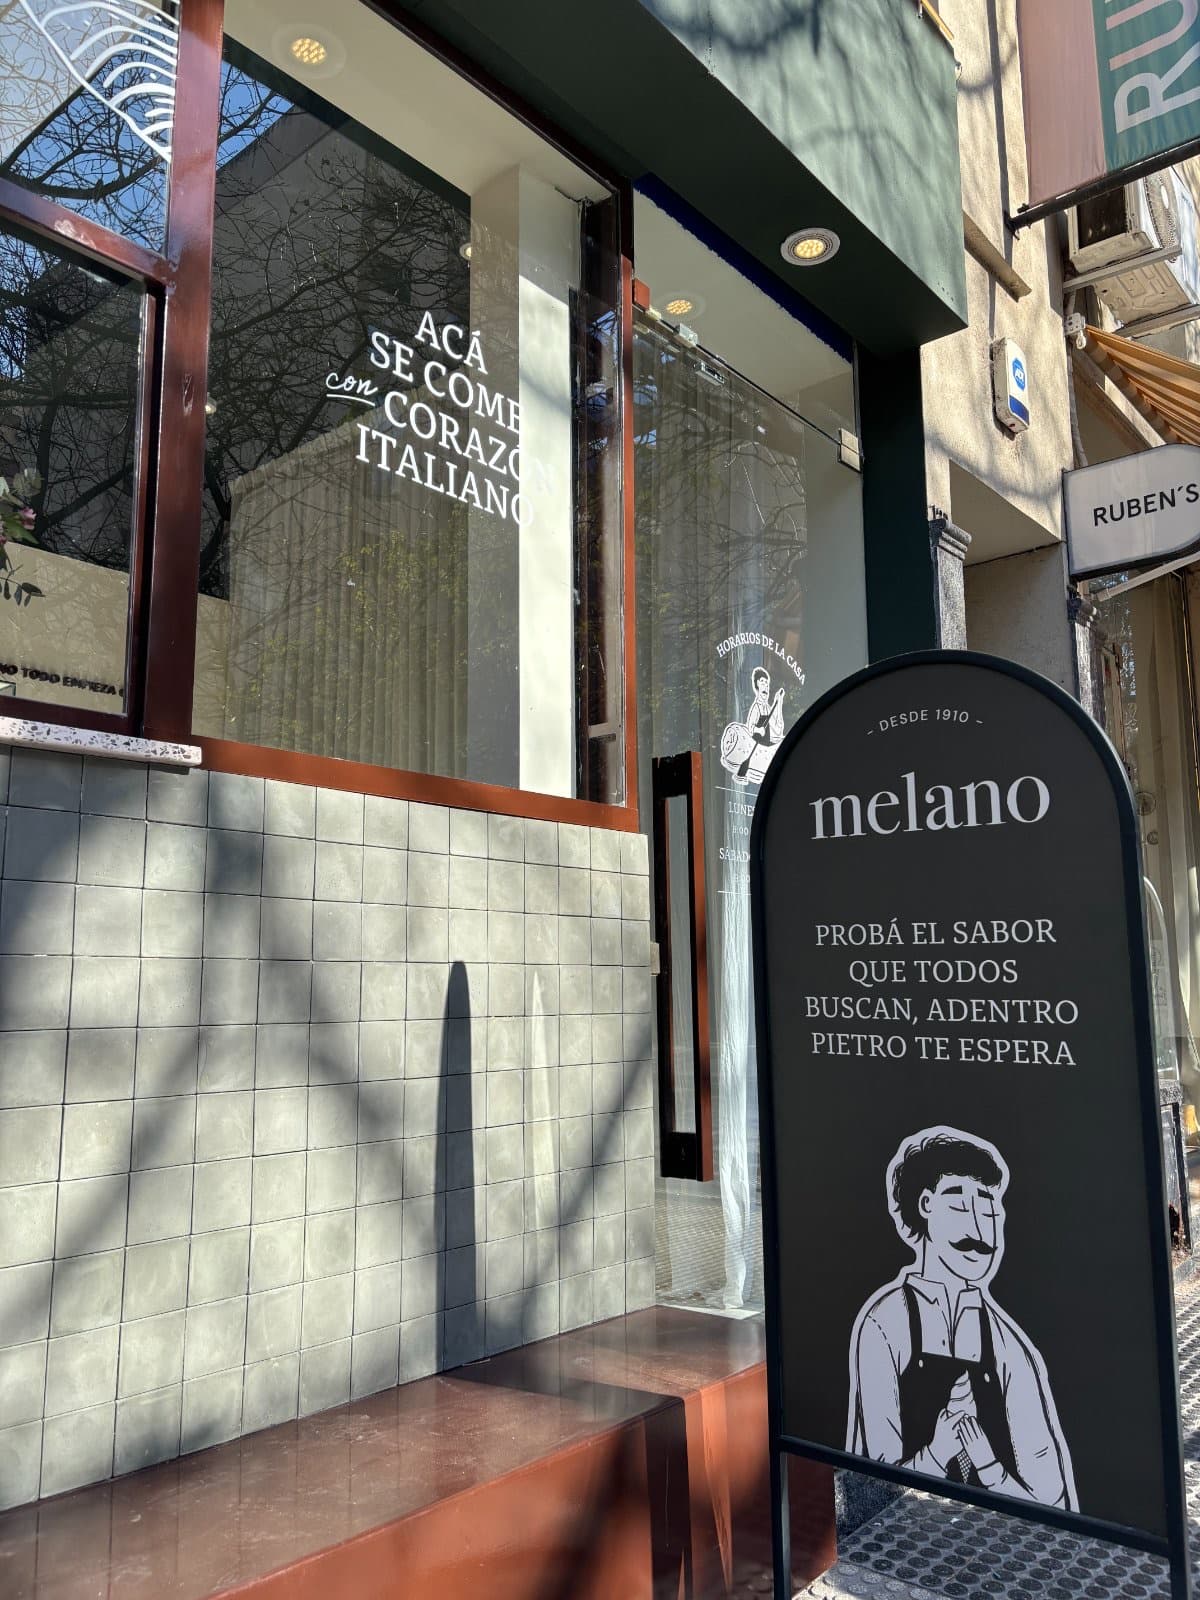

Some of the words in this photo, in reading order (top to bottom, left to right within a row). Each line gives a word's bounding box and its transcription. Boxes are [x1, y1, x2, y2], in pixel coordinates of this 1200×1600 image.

[414, 310, 489, 375] ACÁ
[325, 372, 378, 397] con
[370, 331, 414, 383] SE
[424, 361, 522, 434] COME
[356, 423, 535, 528] ITALIANO
[716, 631, 761, 658] HORARIOS
[761, 634, 774, 651] DE
[774, 643, 786, 661] LA
[786, 655, 806, 686] CASA
[21, 667, 60, 683] TODO
[879, 709, 929, 732] DESDE
[935, 708, 969, 723] 1910
[808, 771, 1051, 840] melano
[719, 846, 751, 863] SÁBAD
[815, 917, 905, 946] PROBÁ
[911, 922, 945, 945] EL
[953, 918, 1057, 945] SABOR
[849, 960, 907, 988] QUE
[913, 959, 1019, 984] TODOS
[804, 996, 919, 1026] BUSCAN,
[926, 998, 1079, 1025] ADENTRO
[811, 1032, 907, 1059] PIETRO
[914, 1036, 951, 1061] TE
[957, 1037, 1077, 1066] ESPERA
